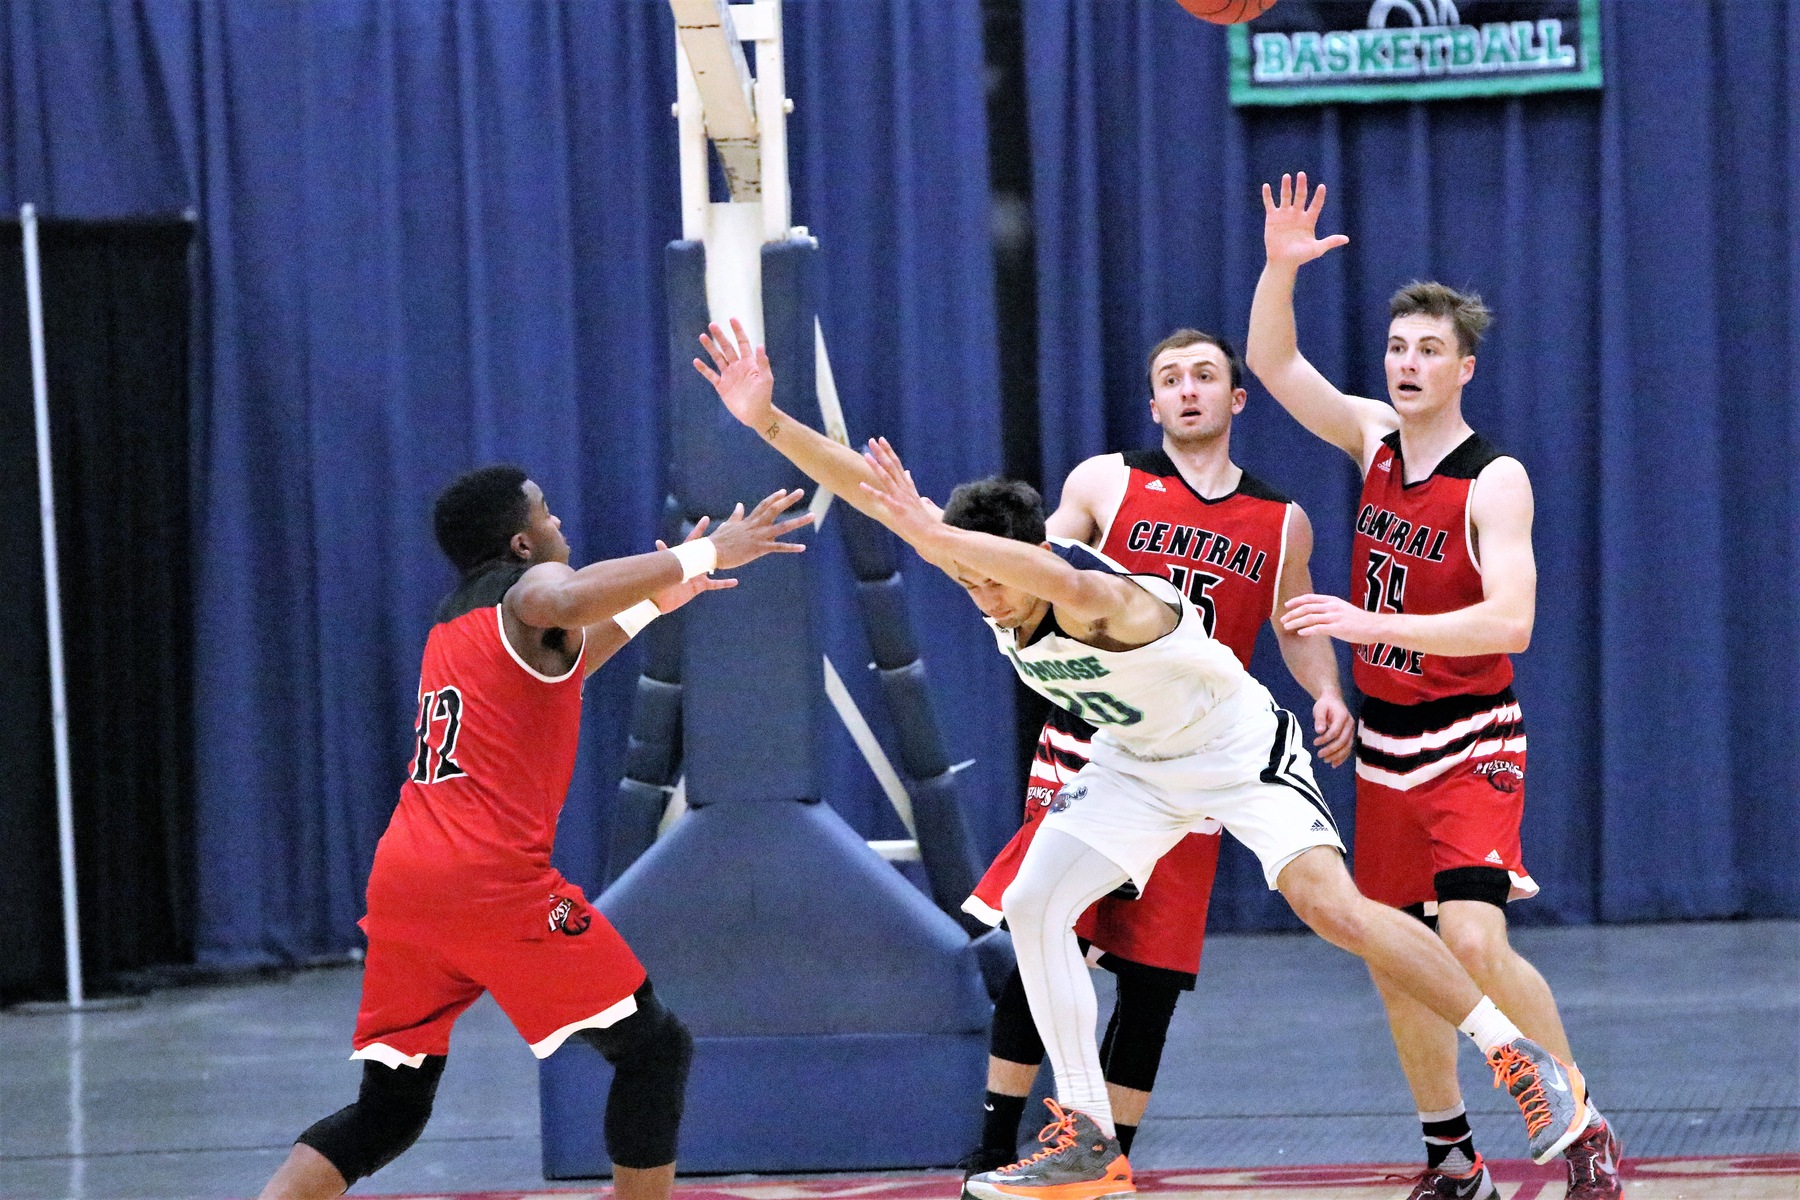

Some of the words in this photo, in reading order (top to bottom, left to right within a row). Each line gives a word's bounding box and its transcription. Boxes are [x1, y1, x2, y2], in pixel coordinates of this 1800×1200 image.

[1254, 20, 1576, 82] BASKETBALL
[1127, 520, 1267, 583] CENTRAL
[1357, 642, 1425, 676] INE
